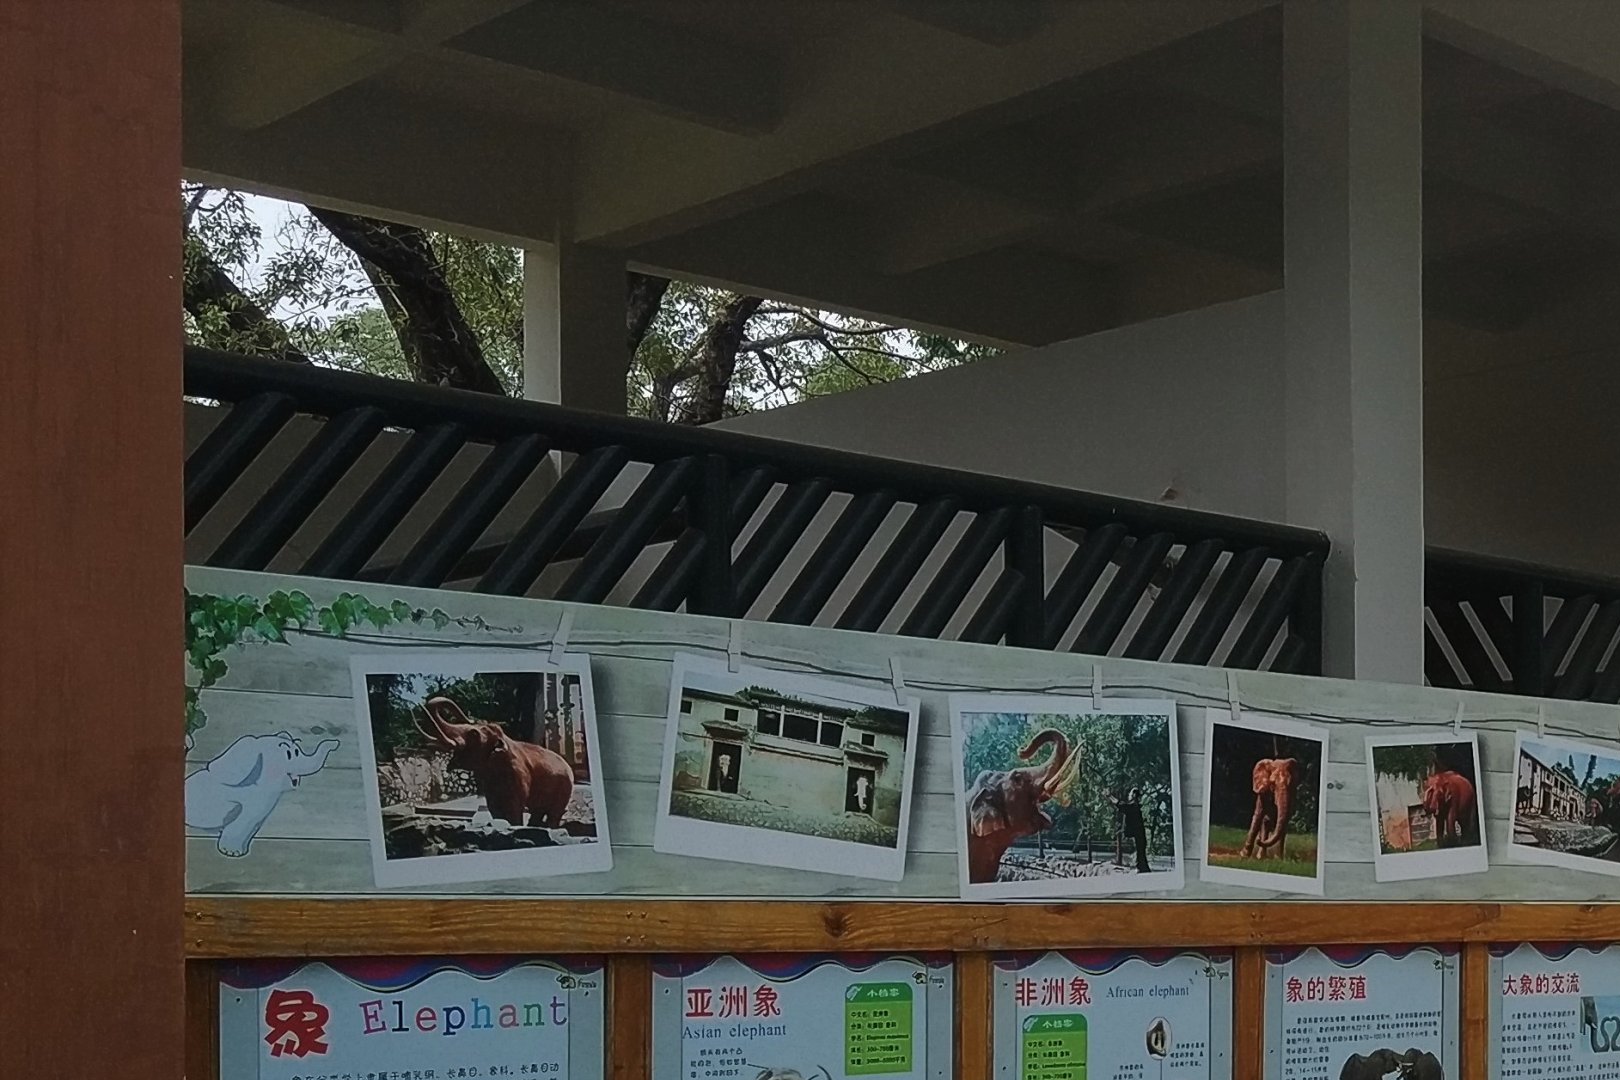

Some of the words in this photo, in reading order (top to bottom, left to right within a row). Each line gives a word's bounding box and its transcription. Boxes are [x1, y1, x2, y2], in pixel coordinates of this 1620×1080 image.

[1015, 976, 1092, 1007] 非洲象
[1106, 985, 1144, 998] African
[1149, 986, 1190, 999] elephant
[1286, 975, 1367, 1003] 象的繁殖
[1502, 973, 1580, 995] 大象的交流
[360, 995, 568, 1036] Elephant
[685, 984, 781, 1018] 亚洲象
[264, 989, 329, 1058] 象
[682, 1026, 722, 1040] Asian
[729, 1024, 787, 1040] elephant
